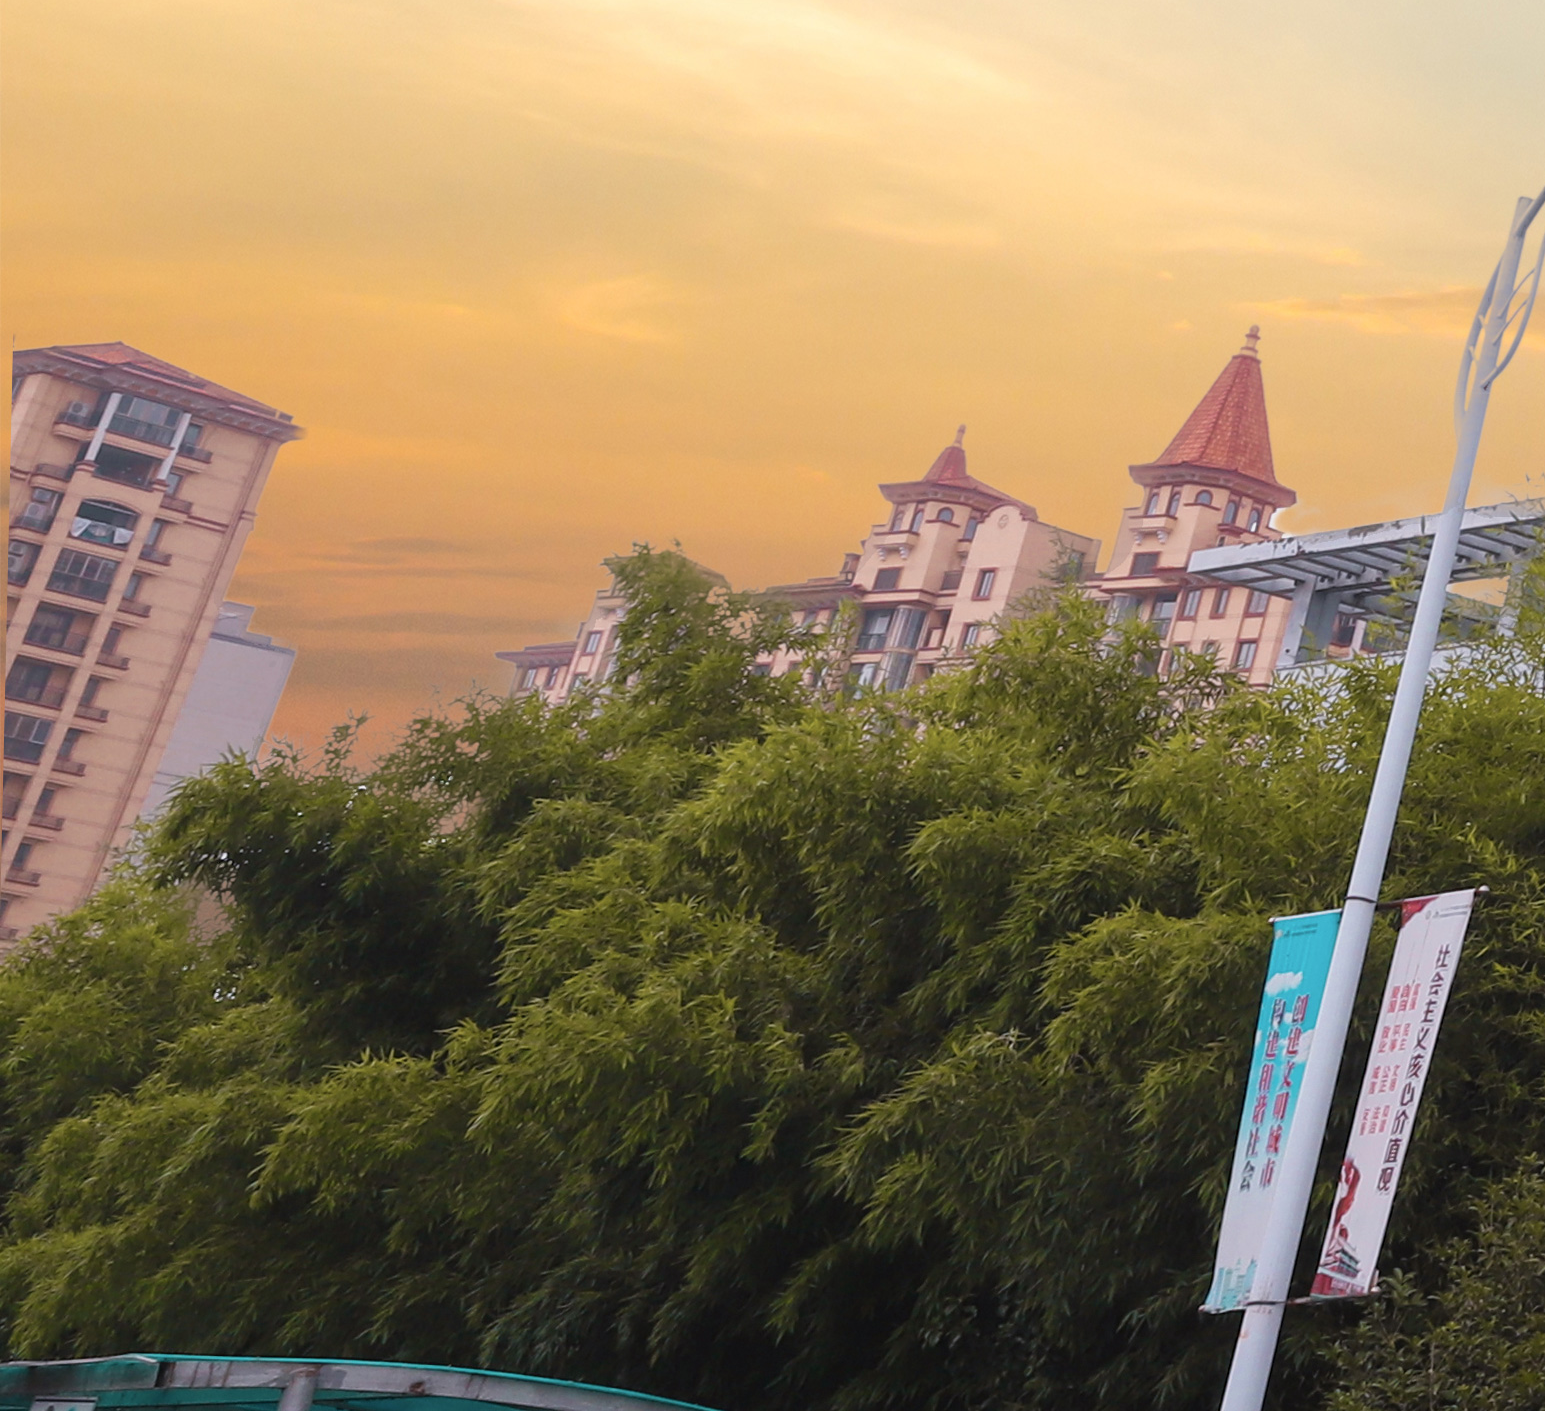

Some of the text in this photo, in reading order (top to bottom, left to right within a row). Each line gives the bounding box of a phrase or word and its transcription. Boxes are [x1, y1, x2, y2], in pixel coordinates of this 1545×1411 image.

[1377, 943, 1451, 1193] 社会主义核心价值观
